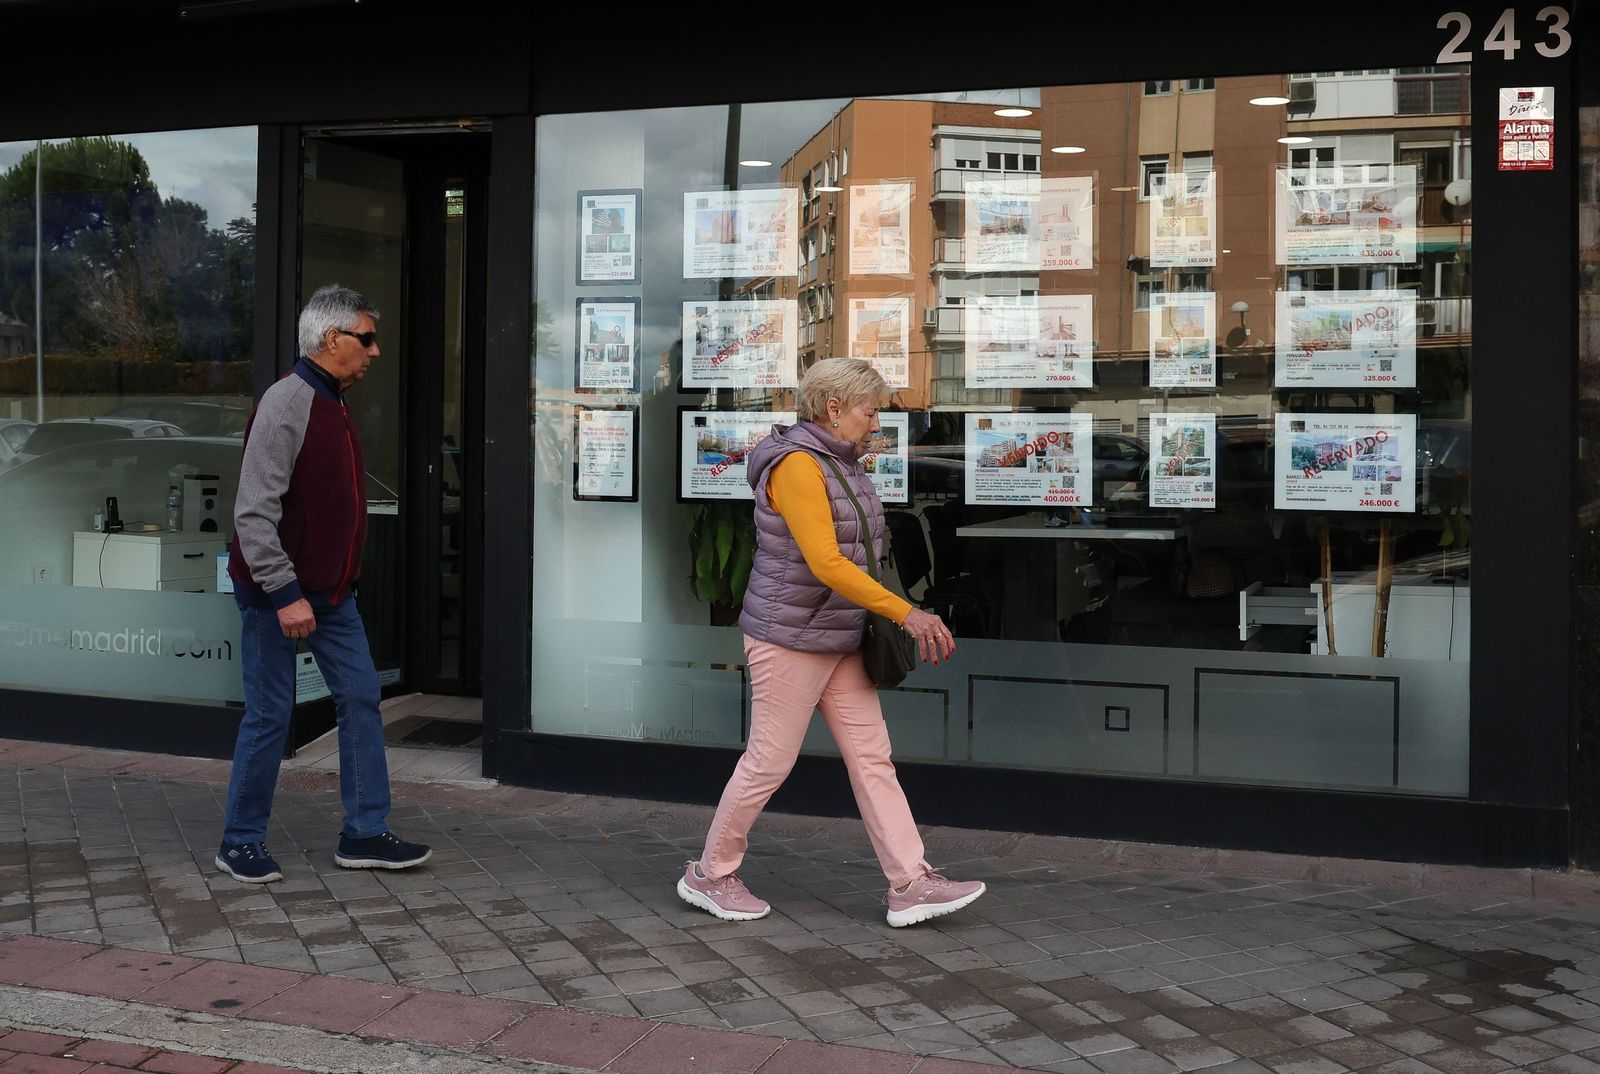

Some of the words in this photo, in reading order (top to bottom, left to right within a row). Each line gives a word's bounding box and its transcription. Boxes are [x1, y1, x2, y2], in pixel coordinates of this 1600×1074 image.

[1436, 5, 1572, 64] 243
[1503, 122, 1550, 134] Alarma
[1361, 249, 1393, 257] 435.000
[998, 431, 1059, 467] VENDIDO
[1303, 430, 1388, 479] RESERVADO
